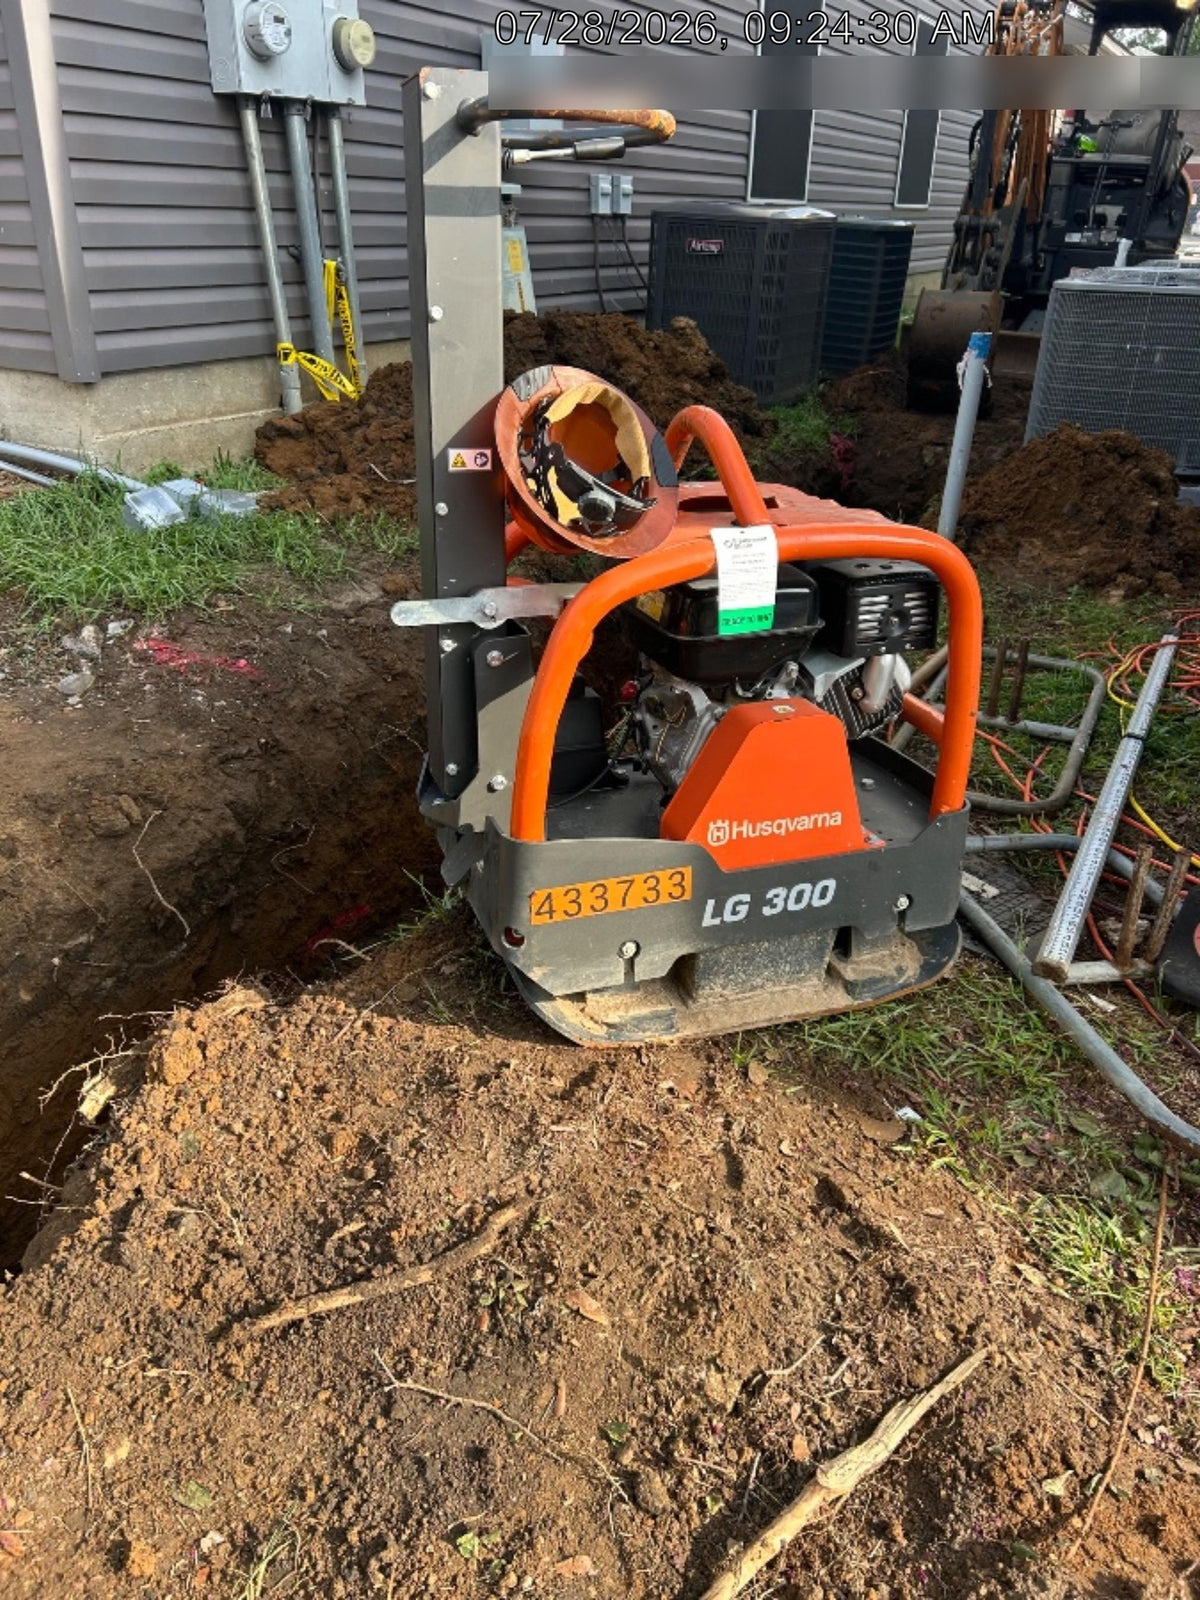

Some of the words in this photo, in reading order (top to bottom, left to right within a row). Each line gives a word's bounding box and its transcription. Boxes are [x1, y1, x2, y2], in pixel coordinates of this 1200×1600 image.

[731, 810, 842, 840] Husqvarna
[534, 870, 687, 920] 433733
[702, 894, 751, 927] LG
[762, 878, 837, 916] 300
